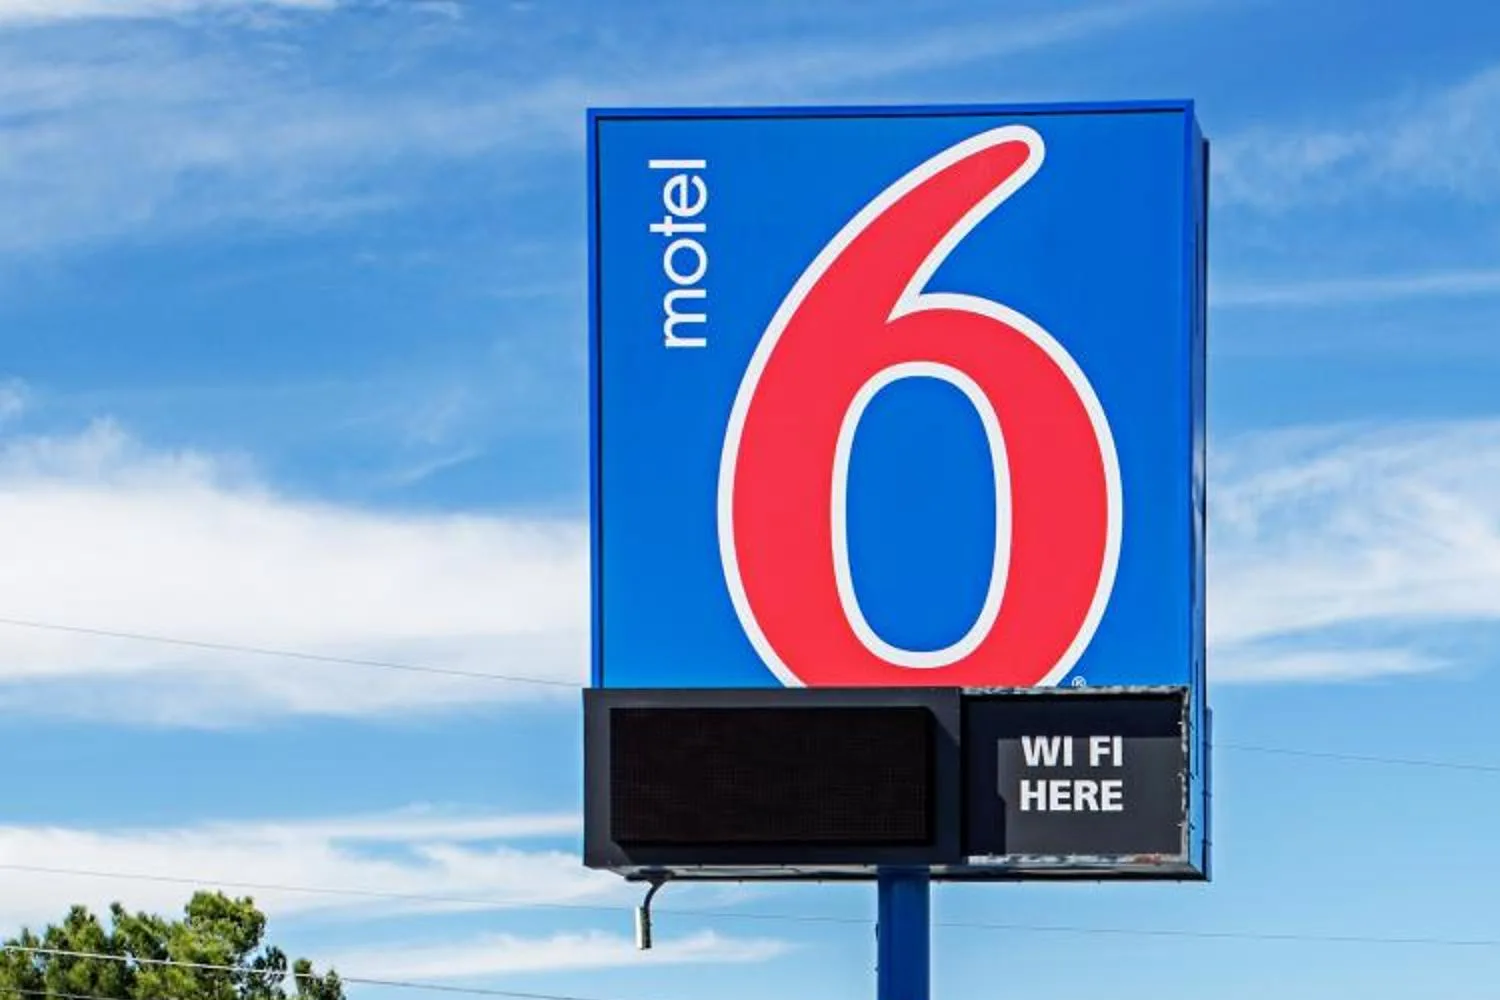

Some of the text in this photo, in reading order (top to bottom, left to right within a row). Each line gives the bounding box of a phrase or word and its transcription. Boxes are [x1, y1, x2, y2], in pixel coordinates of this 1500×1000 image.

[649, 159, 707, 350] motel
[717, 125, 1124, 687] 6
[1020, 778, 1124, 812] HERE
[1021, 735, 1124, 768] WI FI
